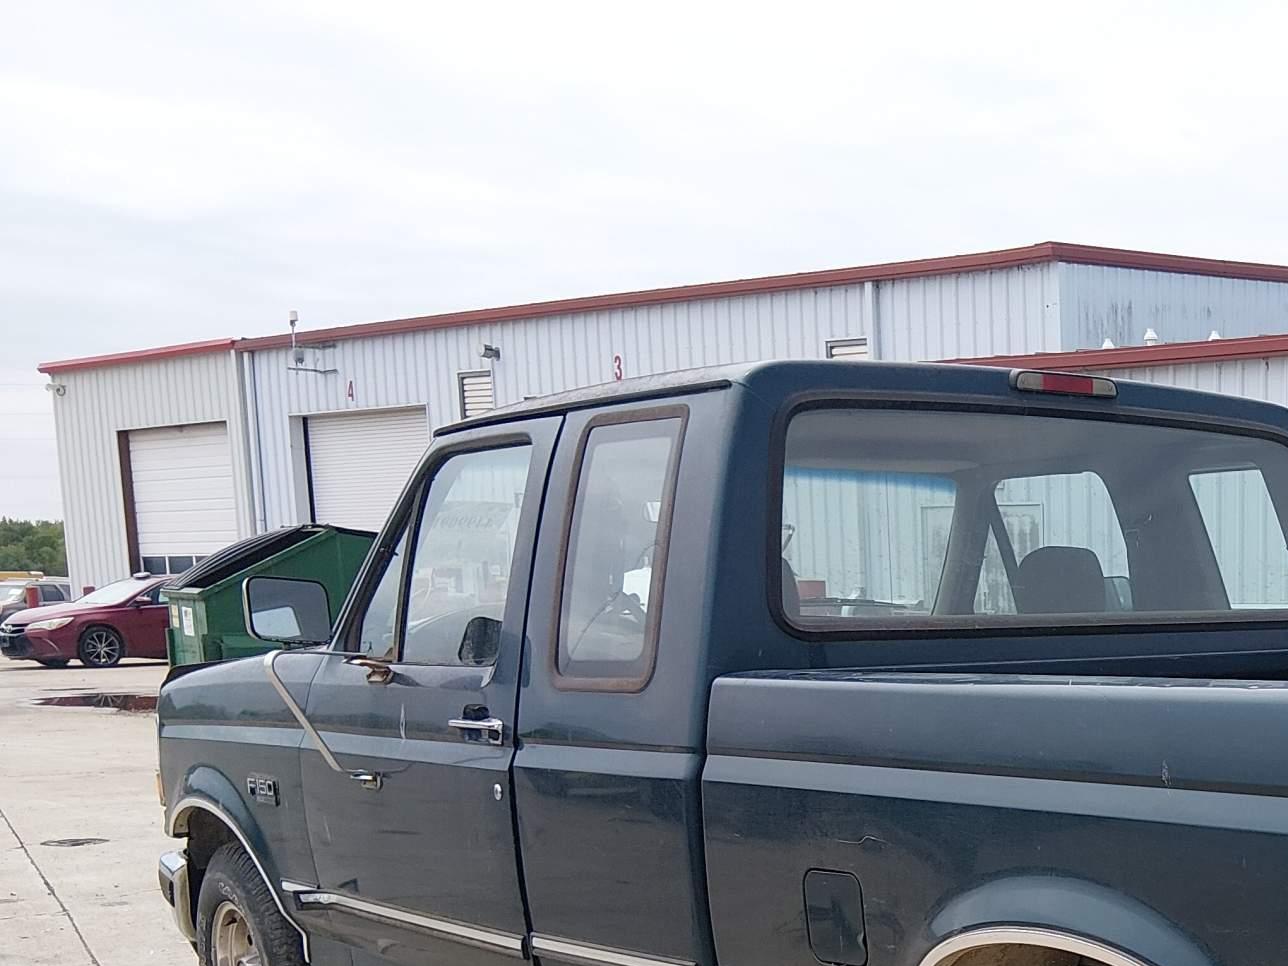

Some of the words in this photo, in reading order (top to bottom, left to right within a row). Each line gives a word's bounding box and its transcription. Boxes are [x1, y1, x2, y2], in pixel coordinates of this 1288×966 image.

[613, 355, 623, 381] 3
[347, 380, 354, 401] 4
[247, 777, 274, 796] F150
